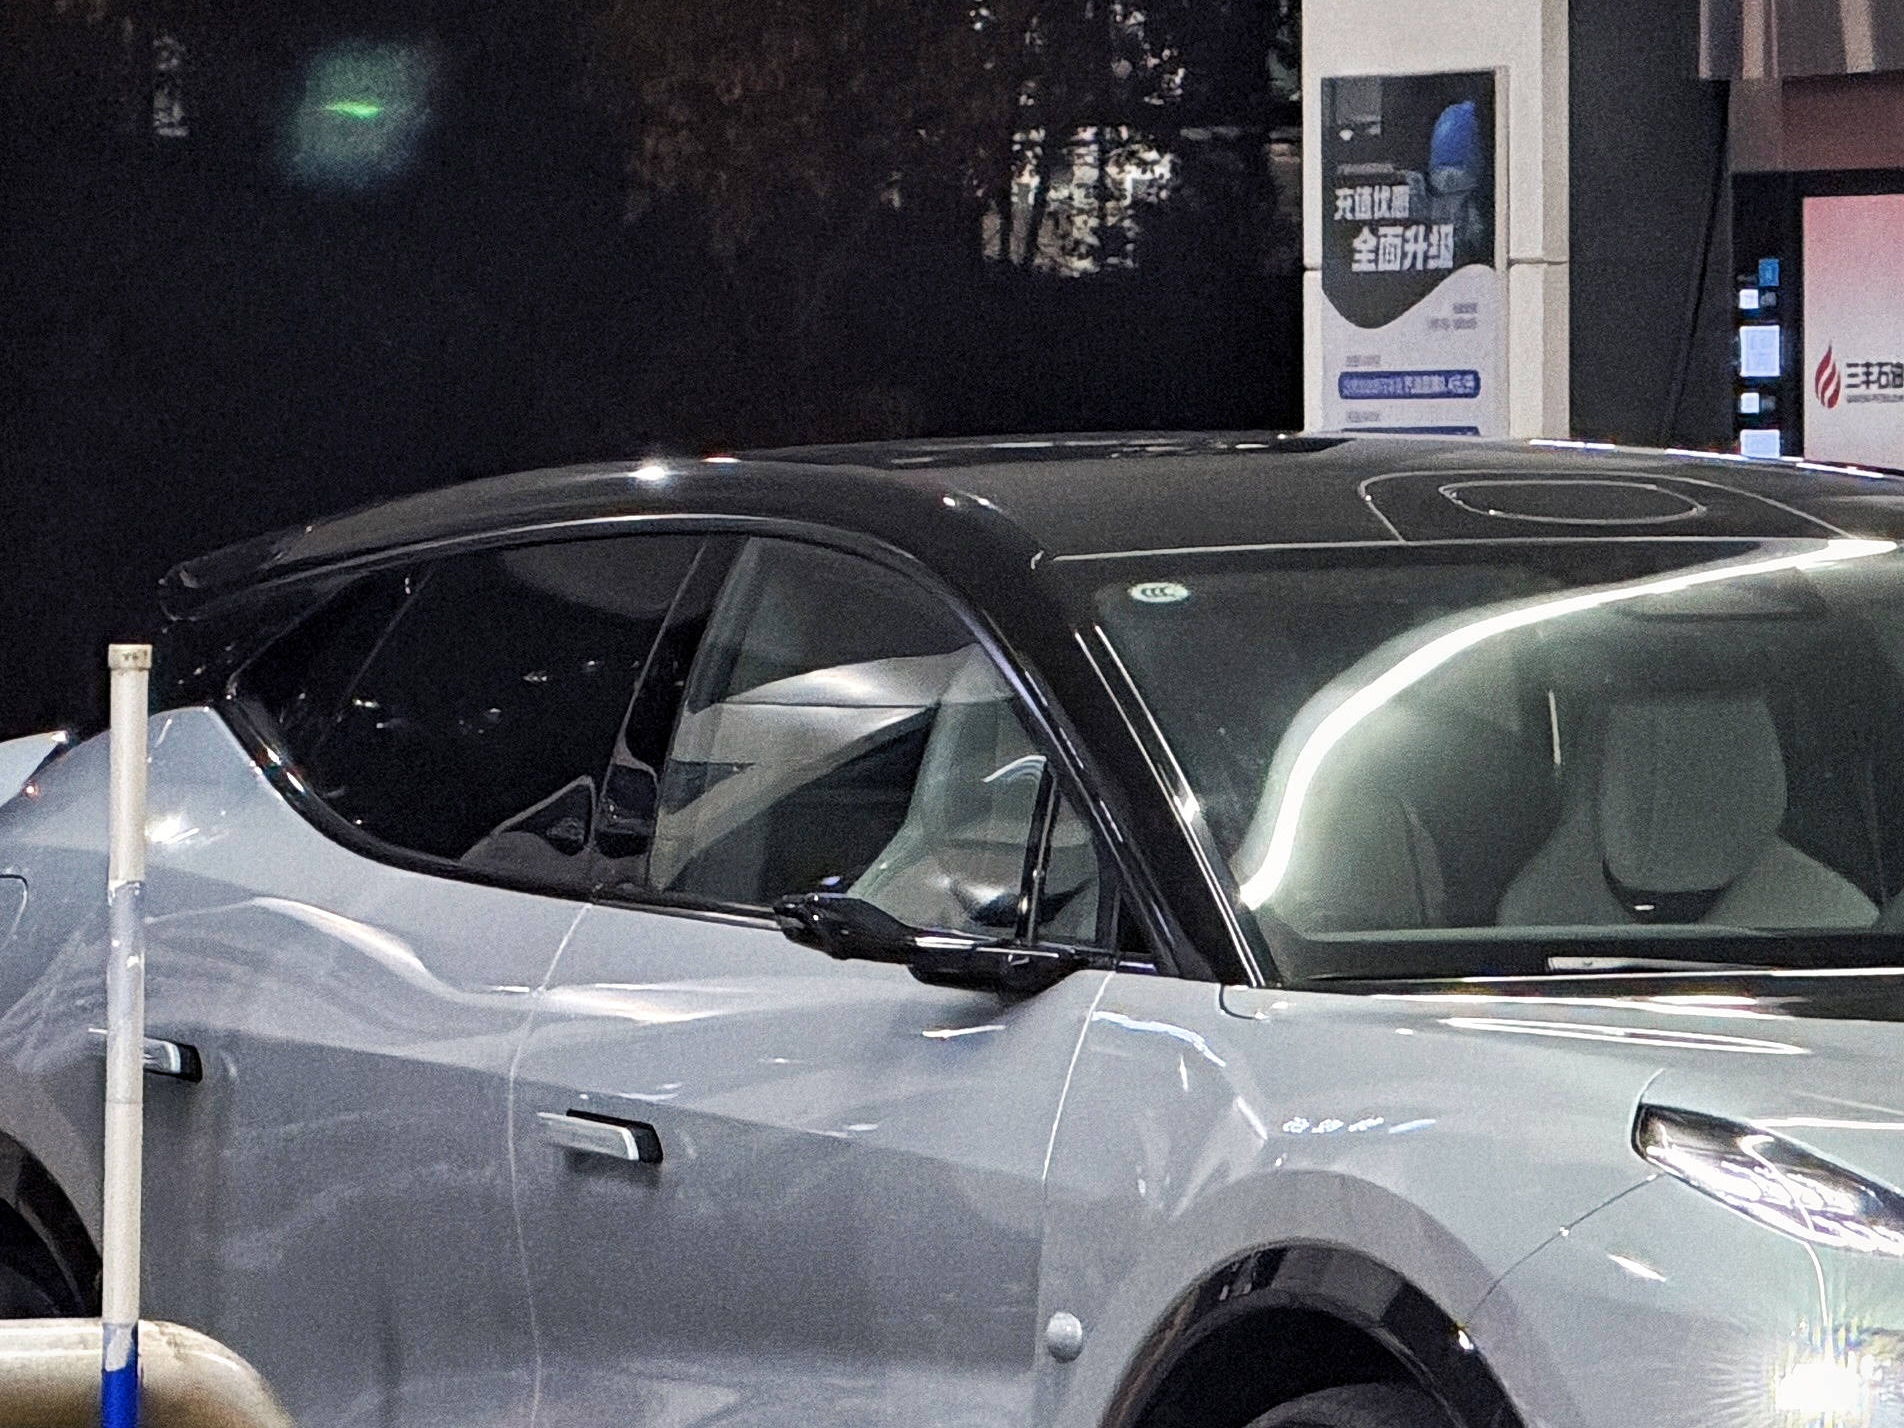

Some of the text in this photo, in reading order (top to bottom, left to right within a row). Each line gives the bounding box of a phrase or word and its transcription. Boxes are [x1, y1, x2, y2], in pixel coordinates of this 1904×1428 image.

[1351, 223, 1454, 272] 全面升级
[1845, 361, 1904, 390] 三丰石油
